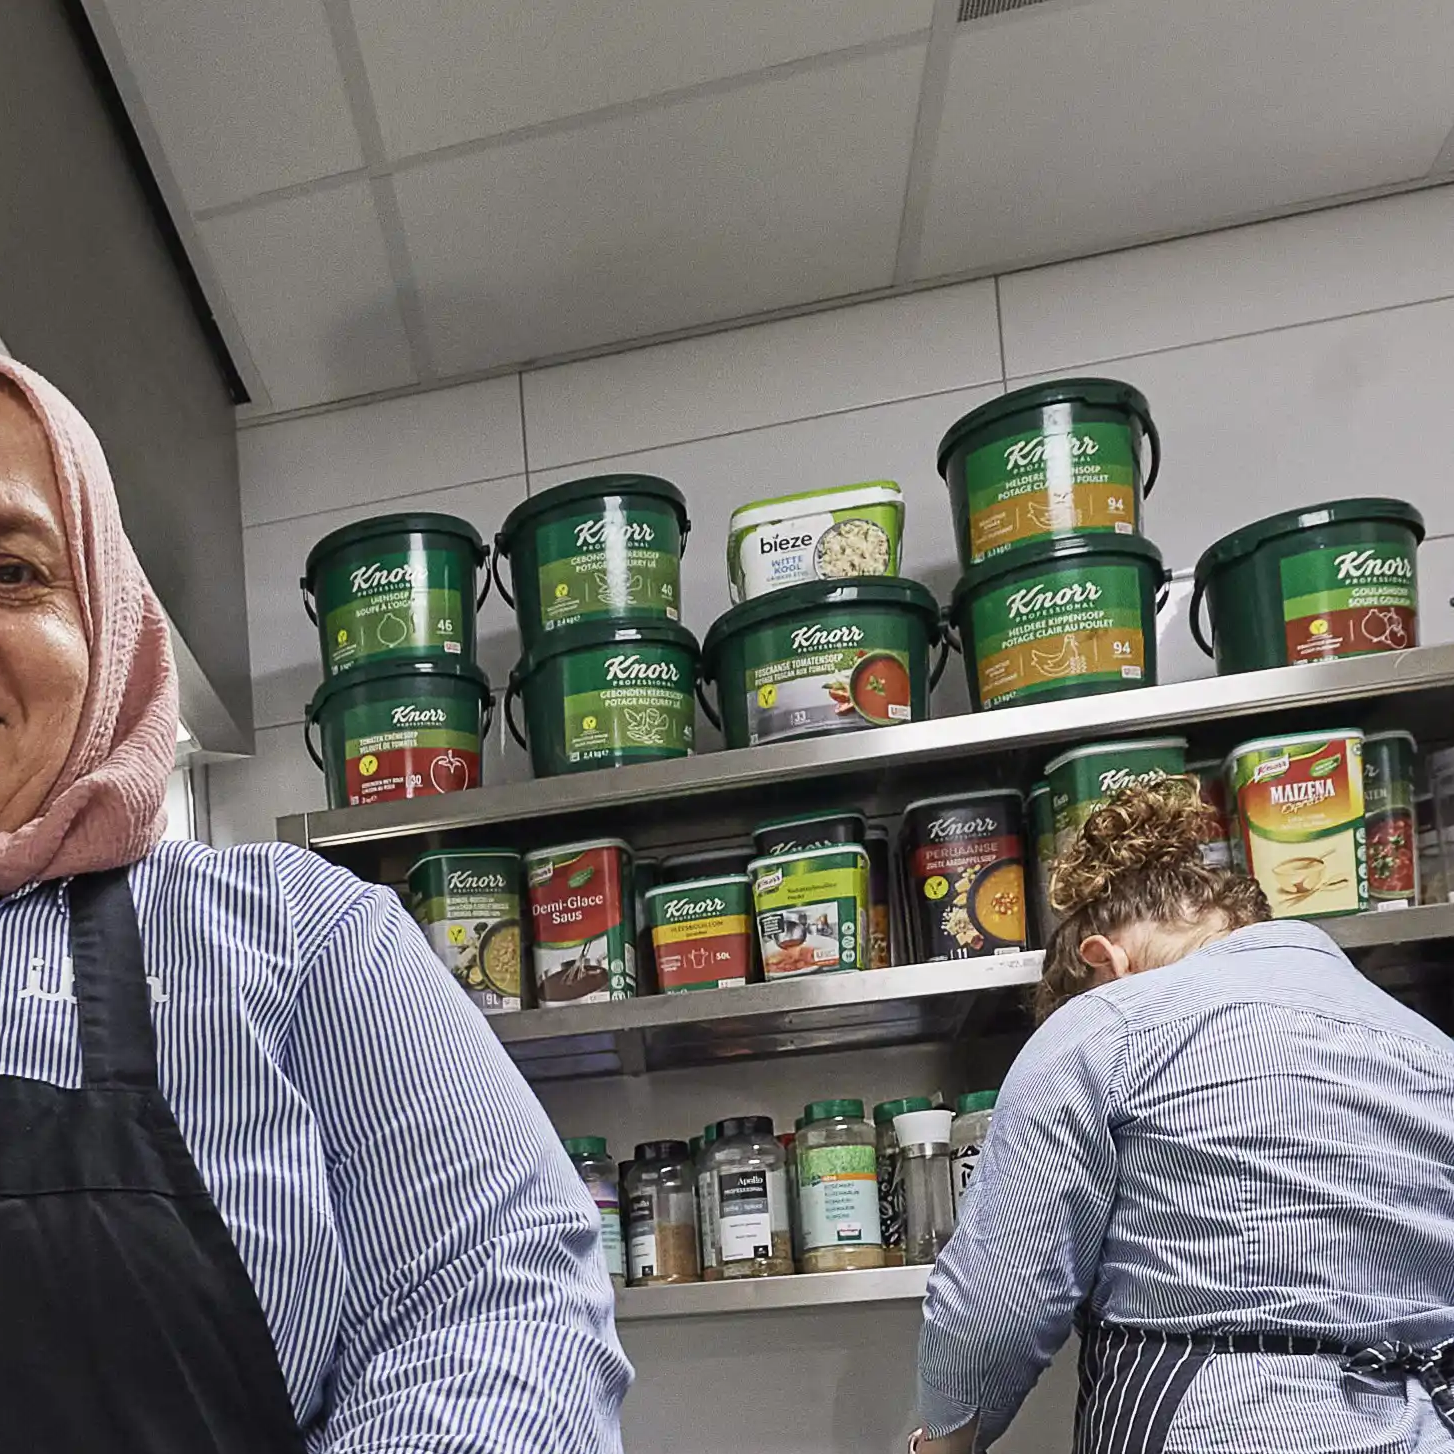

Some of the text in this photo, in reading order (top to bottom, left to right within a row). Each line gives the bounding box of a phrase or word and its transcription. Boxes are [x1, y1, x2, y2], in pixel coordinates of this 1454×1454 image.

[1004, 434, 1099, 470] Knrr
[998, 485, 1031, 501] POTAGE
[1077, 474, 1109, 483] POULET
[1005, 472, 1044, 490] HELDERE
[1107, 497, 1123, 510] 94
[760, 534, 813, 555] bieze
[774, 564, 802, 575] KOOL
[1334, 550, 1413, 579] Knorr
[661, 584, 673, 596] 40
[1006, 581, 1103, 618] Knorr
[1015, 602, 1095, 622] PROFESSIONAL
[437, 619, 453, 631] 46
[1008, 610, 1105, 637] HELDERE KIPPENSOEP
[791, 624, 864, 649] Knorr
[1001, 619, 1114, 649] POTAGE CLAIR AU POULET
[798, 641, 858, 653] PROFESSIONAL
[1113, 642, 1131, 654] 94
[604, 654, 680, 681] Knorr
[792, 653, 844, 669] TOMATENSOEP
[600, 689, 647, 699] GEBONDEN
[605, 698, 638, 707] POTAGE
[391, 705, 447, 724] Knorr
[795, 710, 806, 722] 33
[411, 775, 422, 786] 30
[1270, 778, 1335, 805] MAIZENA
[928, 817, 998, 839] Knorr
[926, 843, 999, 860] PERUAANSE
[448, 870, 506, 888] Knorr
[532, 894, 604, 916] Demi-Glace
[664, 898, 726, 918] Knorr
[552, 910, 583, 924] Saus
